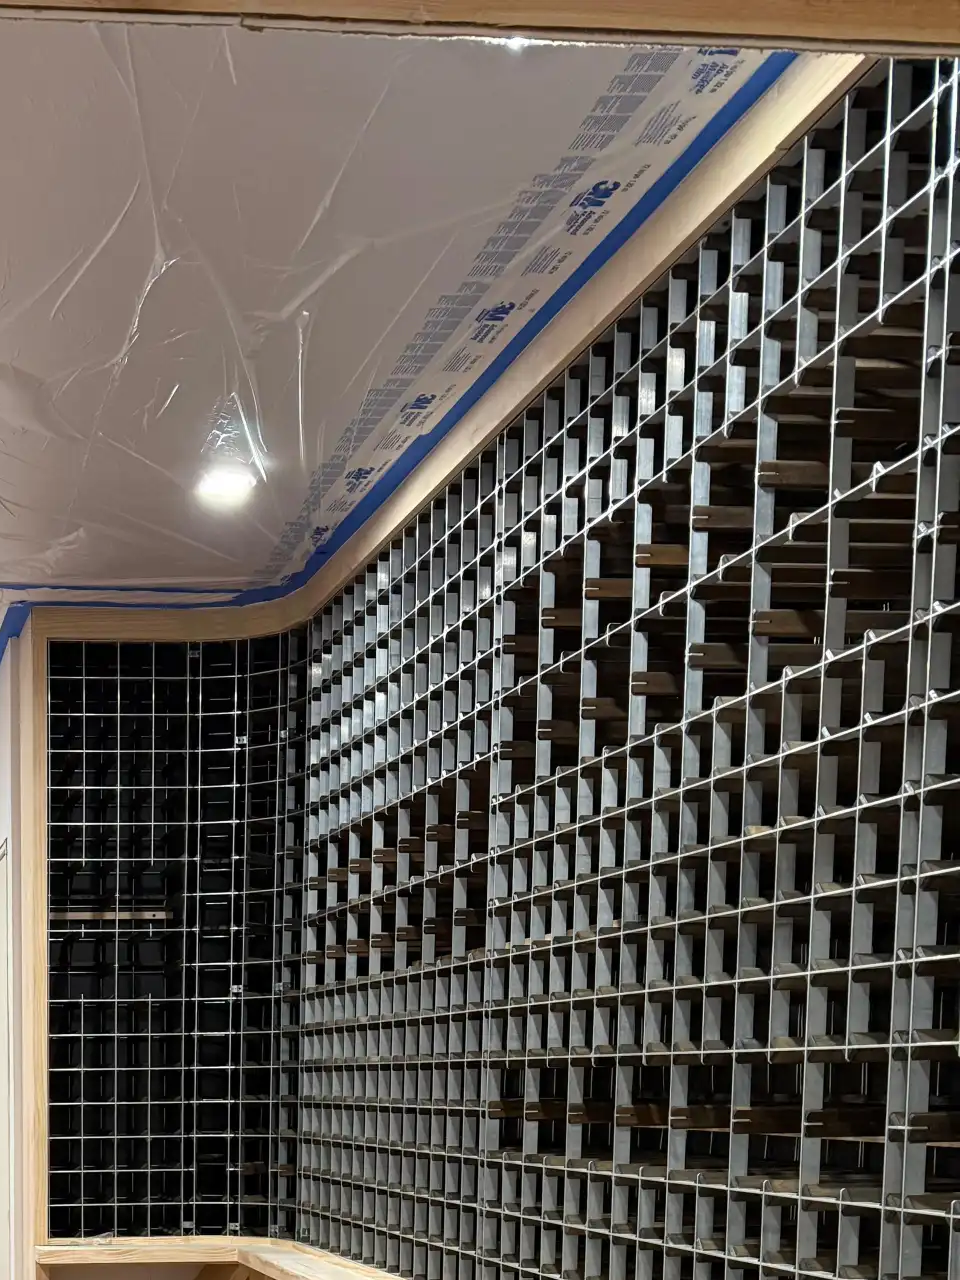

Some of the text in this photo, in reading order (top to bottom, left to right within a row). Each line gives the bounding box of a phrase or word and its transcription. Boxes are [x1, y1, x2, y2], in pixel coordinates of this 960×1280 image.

[579, 180, 621, 209] 3M
[485, 301, 516, 321] 3M
[409, 393, 437, 410] 3M
